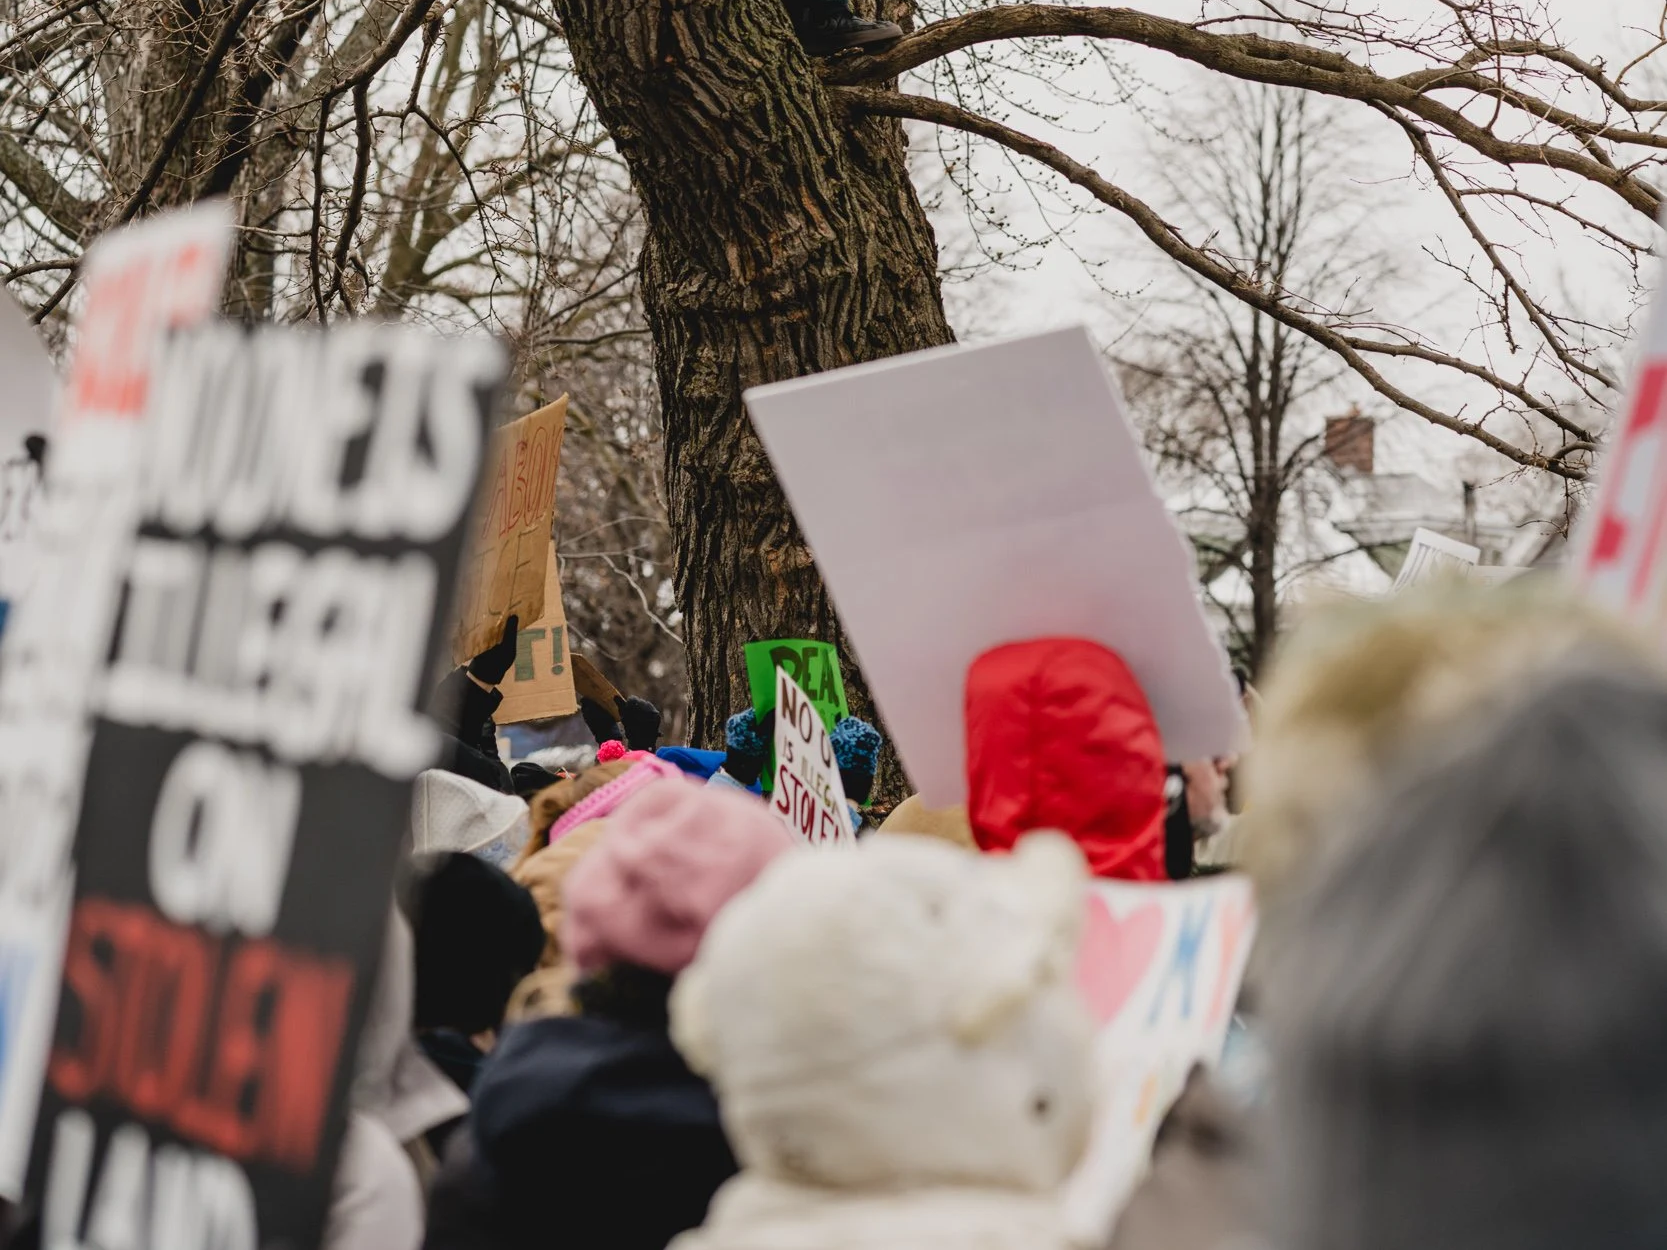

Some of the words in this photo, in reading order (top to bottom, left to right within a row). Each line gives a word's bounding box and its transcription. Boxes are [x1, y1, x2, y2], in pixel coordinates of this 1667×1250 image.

[463, 525, 539, 634] ICE
[781, 677, 813, 745] NO
[782, 735, 795, 764] IS
[147, 739, 303, 937] ON
[48, 895, 356, 1175] STOLEN
